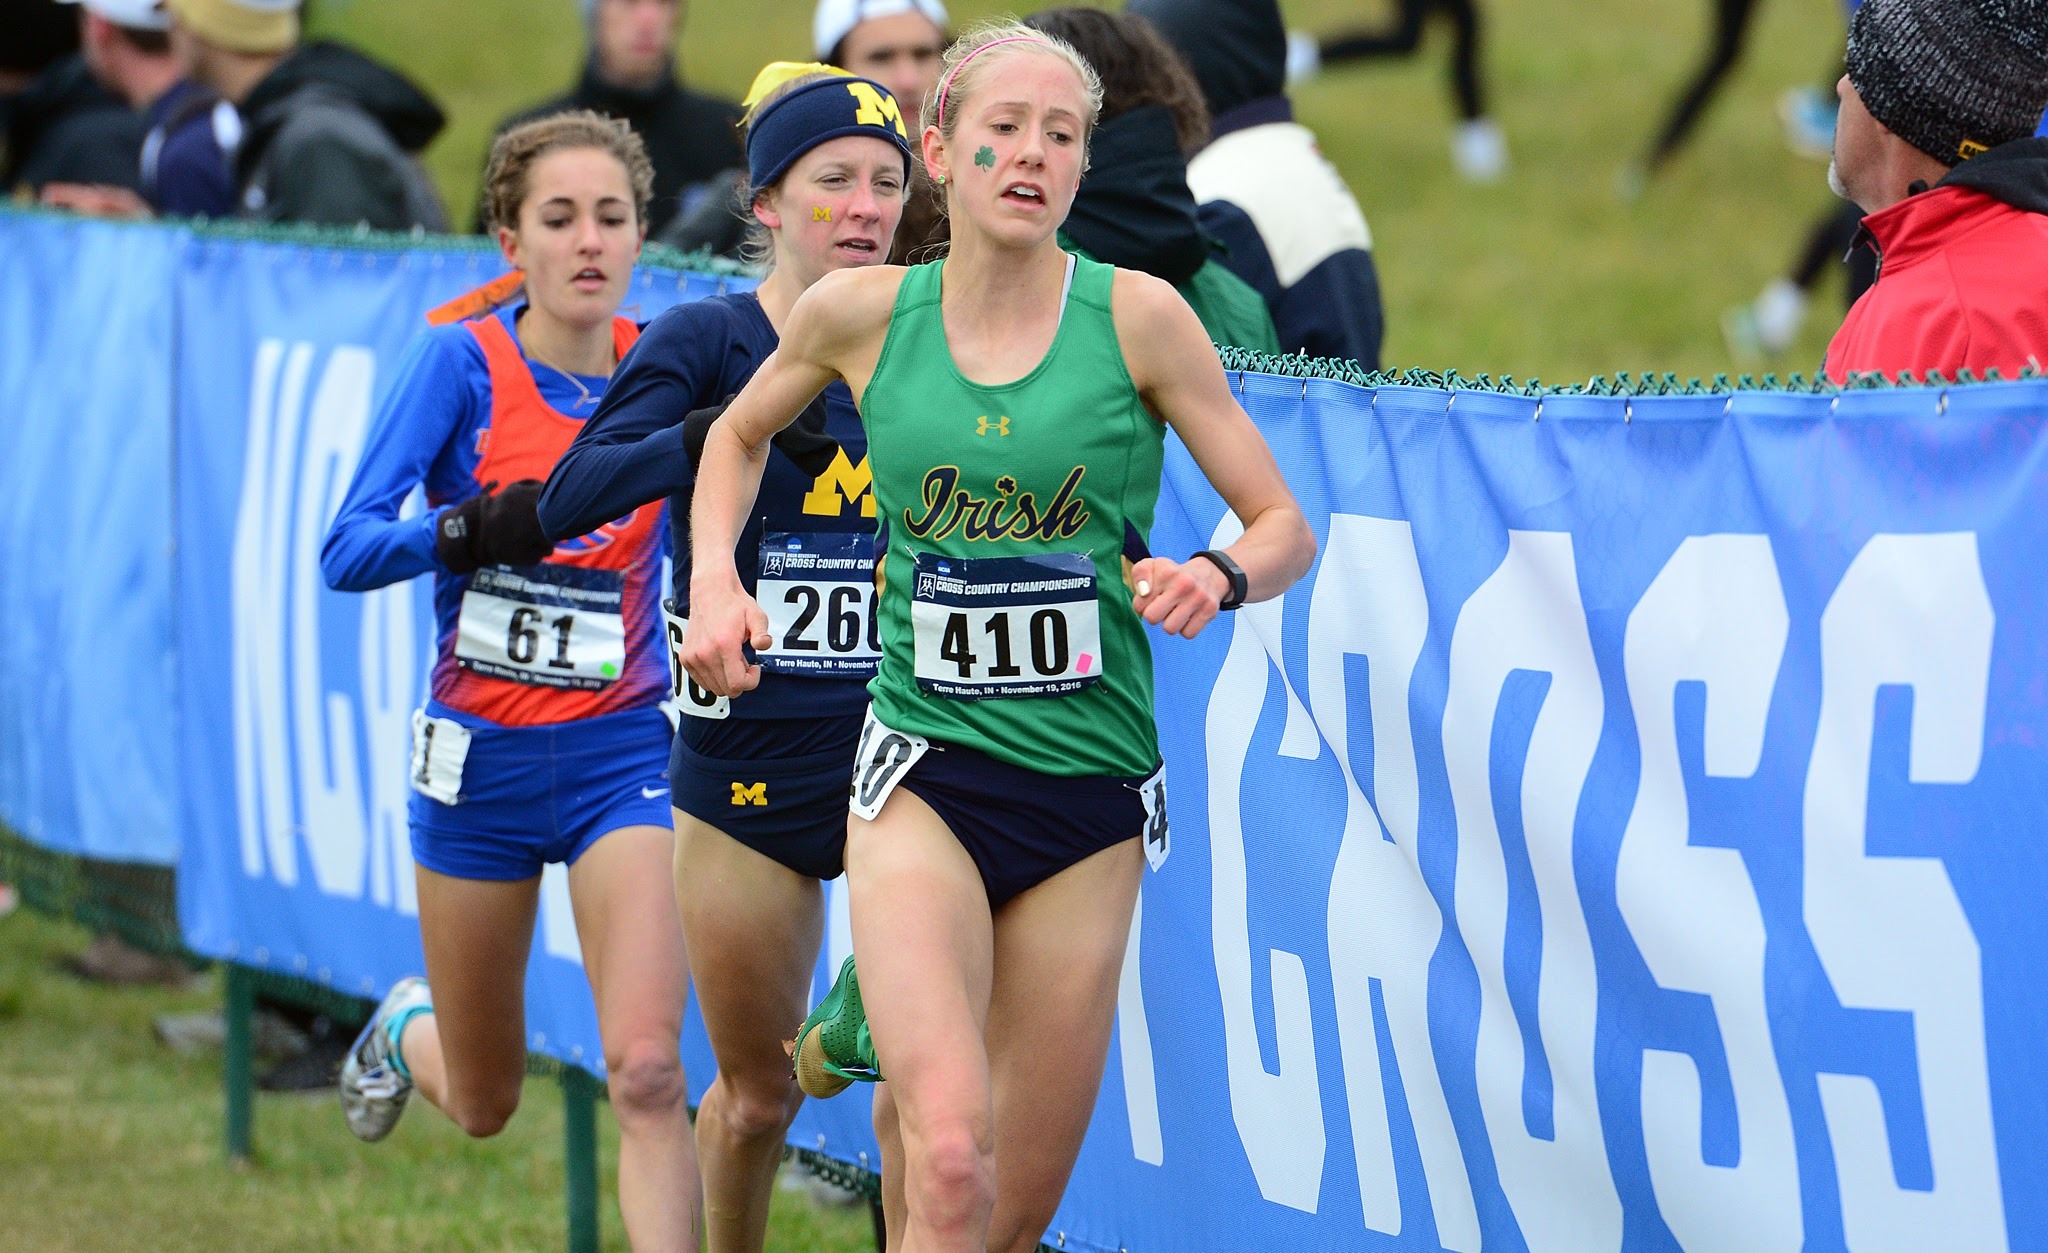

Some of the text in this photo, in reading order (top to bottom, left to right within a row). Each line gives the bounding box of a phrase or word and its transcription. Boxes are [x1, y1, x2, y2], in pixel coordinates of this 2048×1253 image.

[847, 82, 908, 139] M
[811, 205, 833, 222] M
[802, 445, 877, 518] M
[904, 465, 1091, 542] Irish
[785, 558, 815, 569] CROSS
[816, 559, 855, 570] COUNTRY
[936, 577, 1091, 596] CROSS COUNTRY CHAMPIONSHIPS
[507, 607, 575, 670] 61
[940, 609, 1069, 679] 410
[775, 658, 796, 668] Terre
[796, 659, 822, 669] Haute,
[823, 660, 833, 669] IN
[838, 660, 874, 669] November
[932, 683, 954, 694] Terre
[954, 685, 983, 696] Haute,
[984, 686, 995, 695] IN
[1000, 685, 1044, 695] November
[1045, 683, 1059, 693] 19,
[1060, 682, 1082, 691] 2016
[731, 781, 768, 806] M
[1205, 506, 2010, 1253] CROSS
